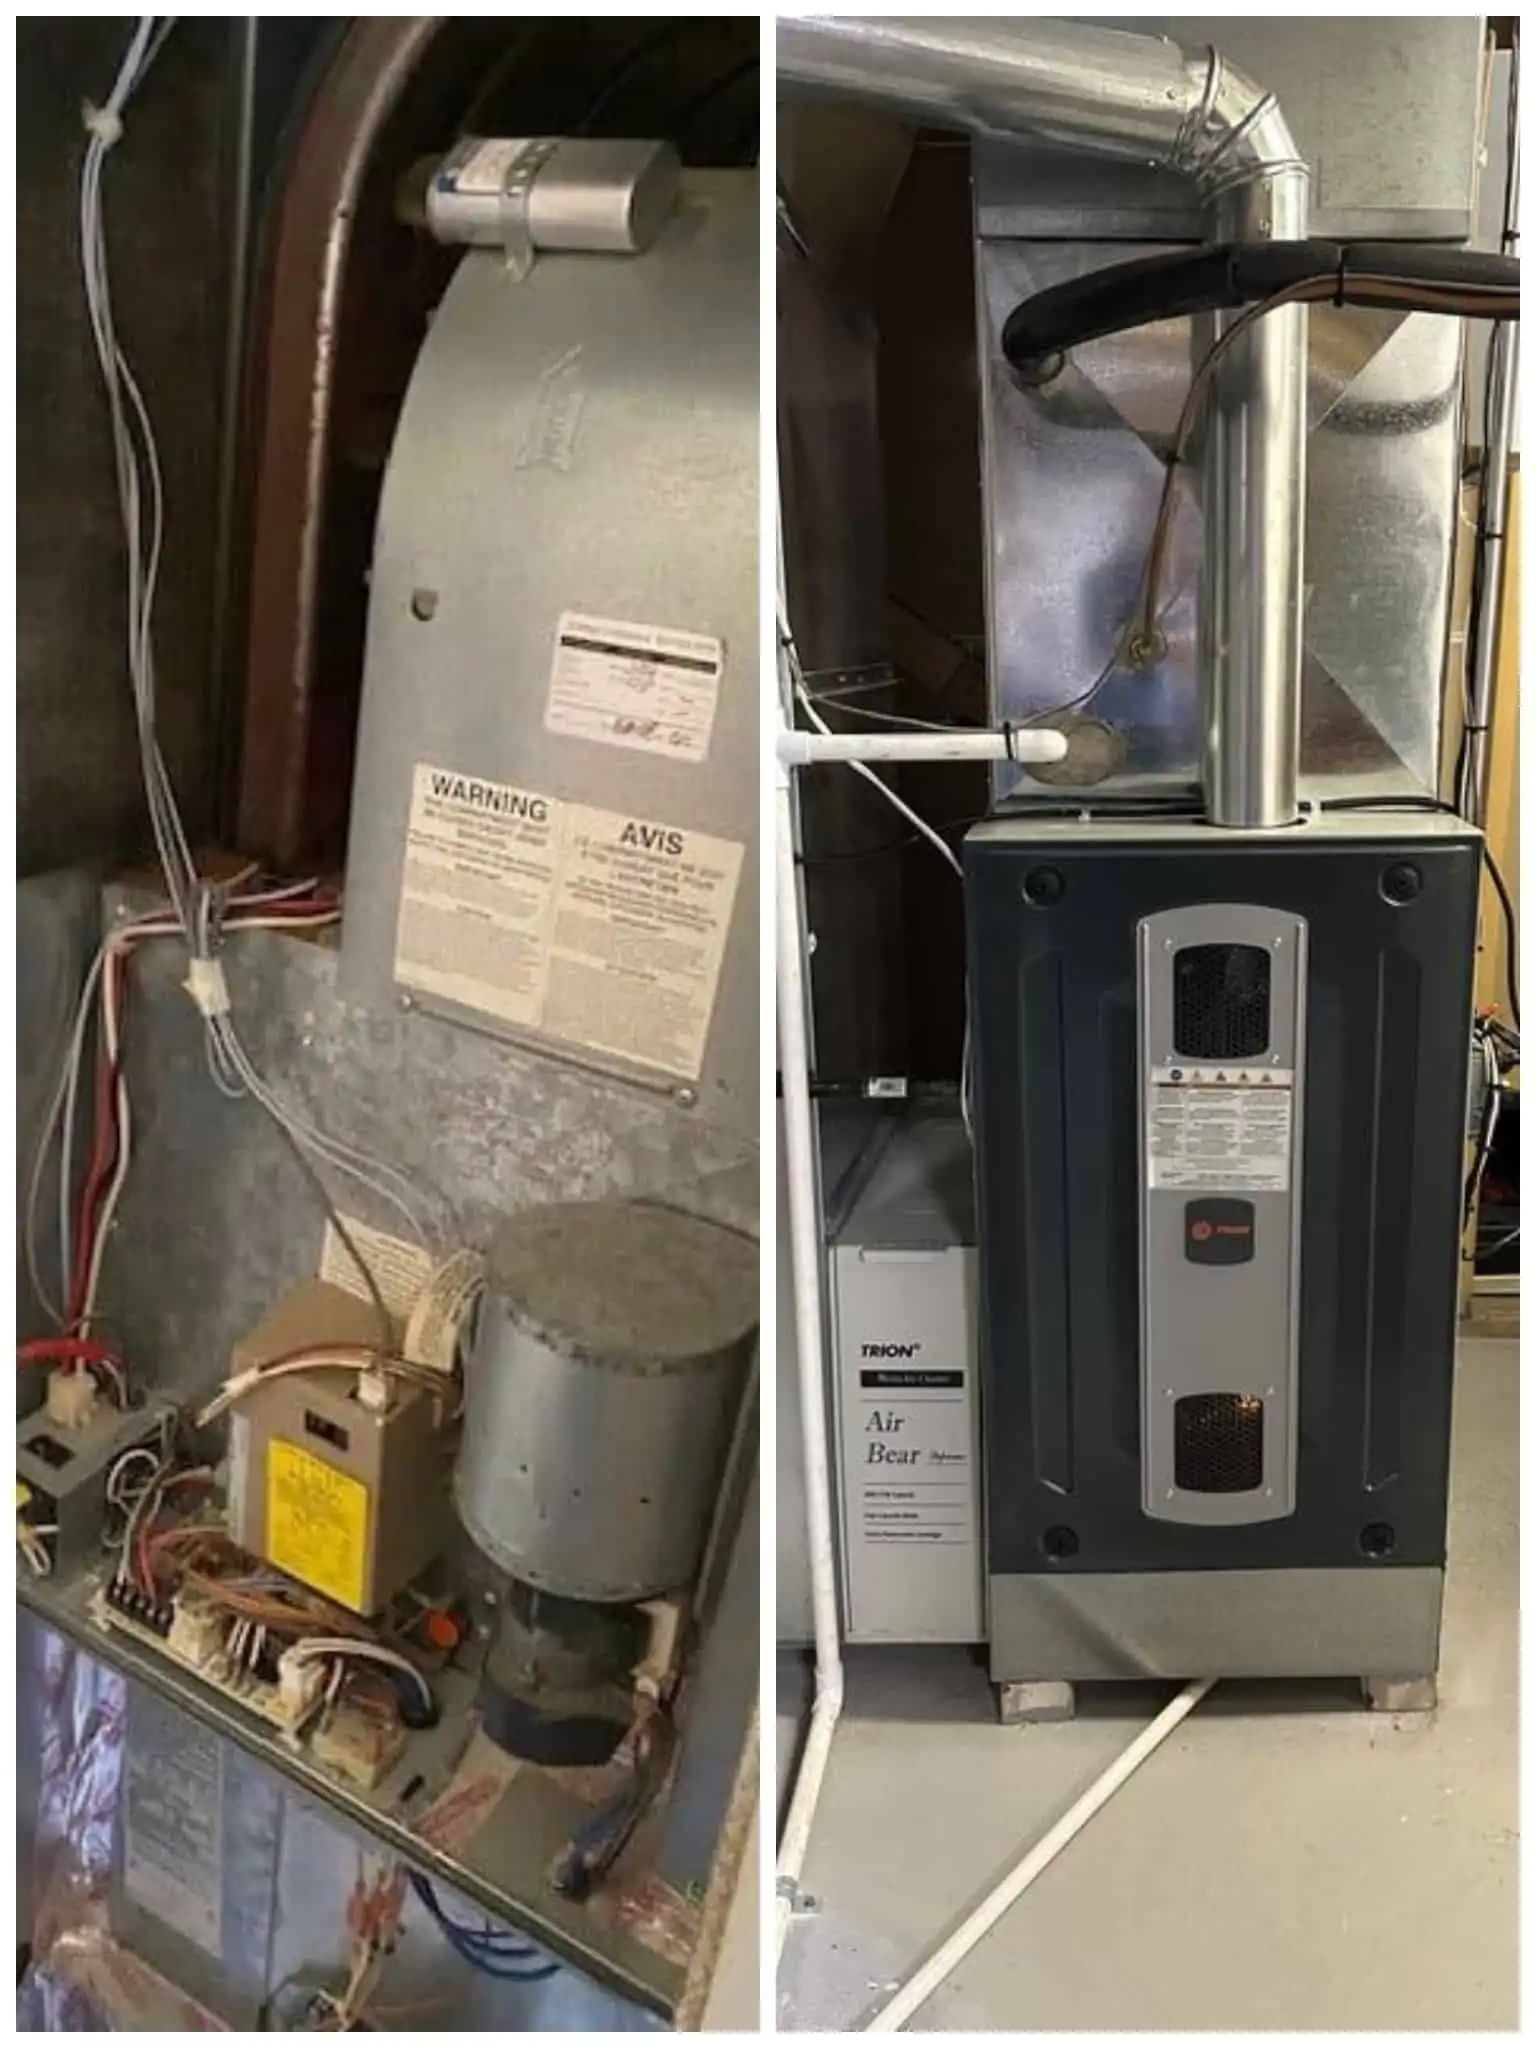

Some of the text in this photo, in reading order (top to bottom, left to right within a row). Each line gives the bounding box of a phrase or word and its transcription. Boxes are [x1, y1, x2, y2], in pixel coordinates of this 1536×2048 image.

[431, 773, 548, 822] WARNING
[619, 821, 684, 855] AVIS
[864, 1410, 906, 1432] Air
[865, 1441, 921, 1464] Bear
